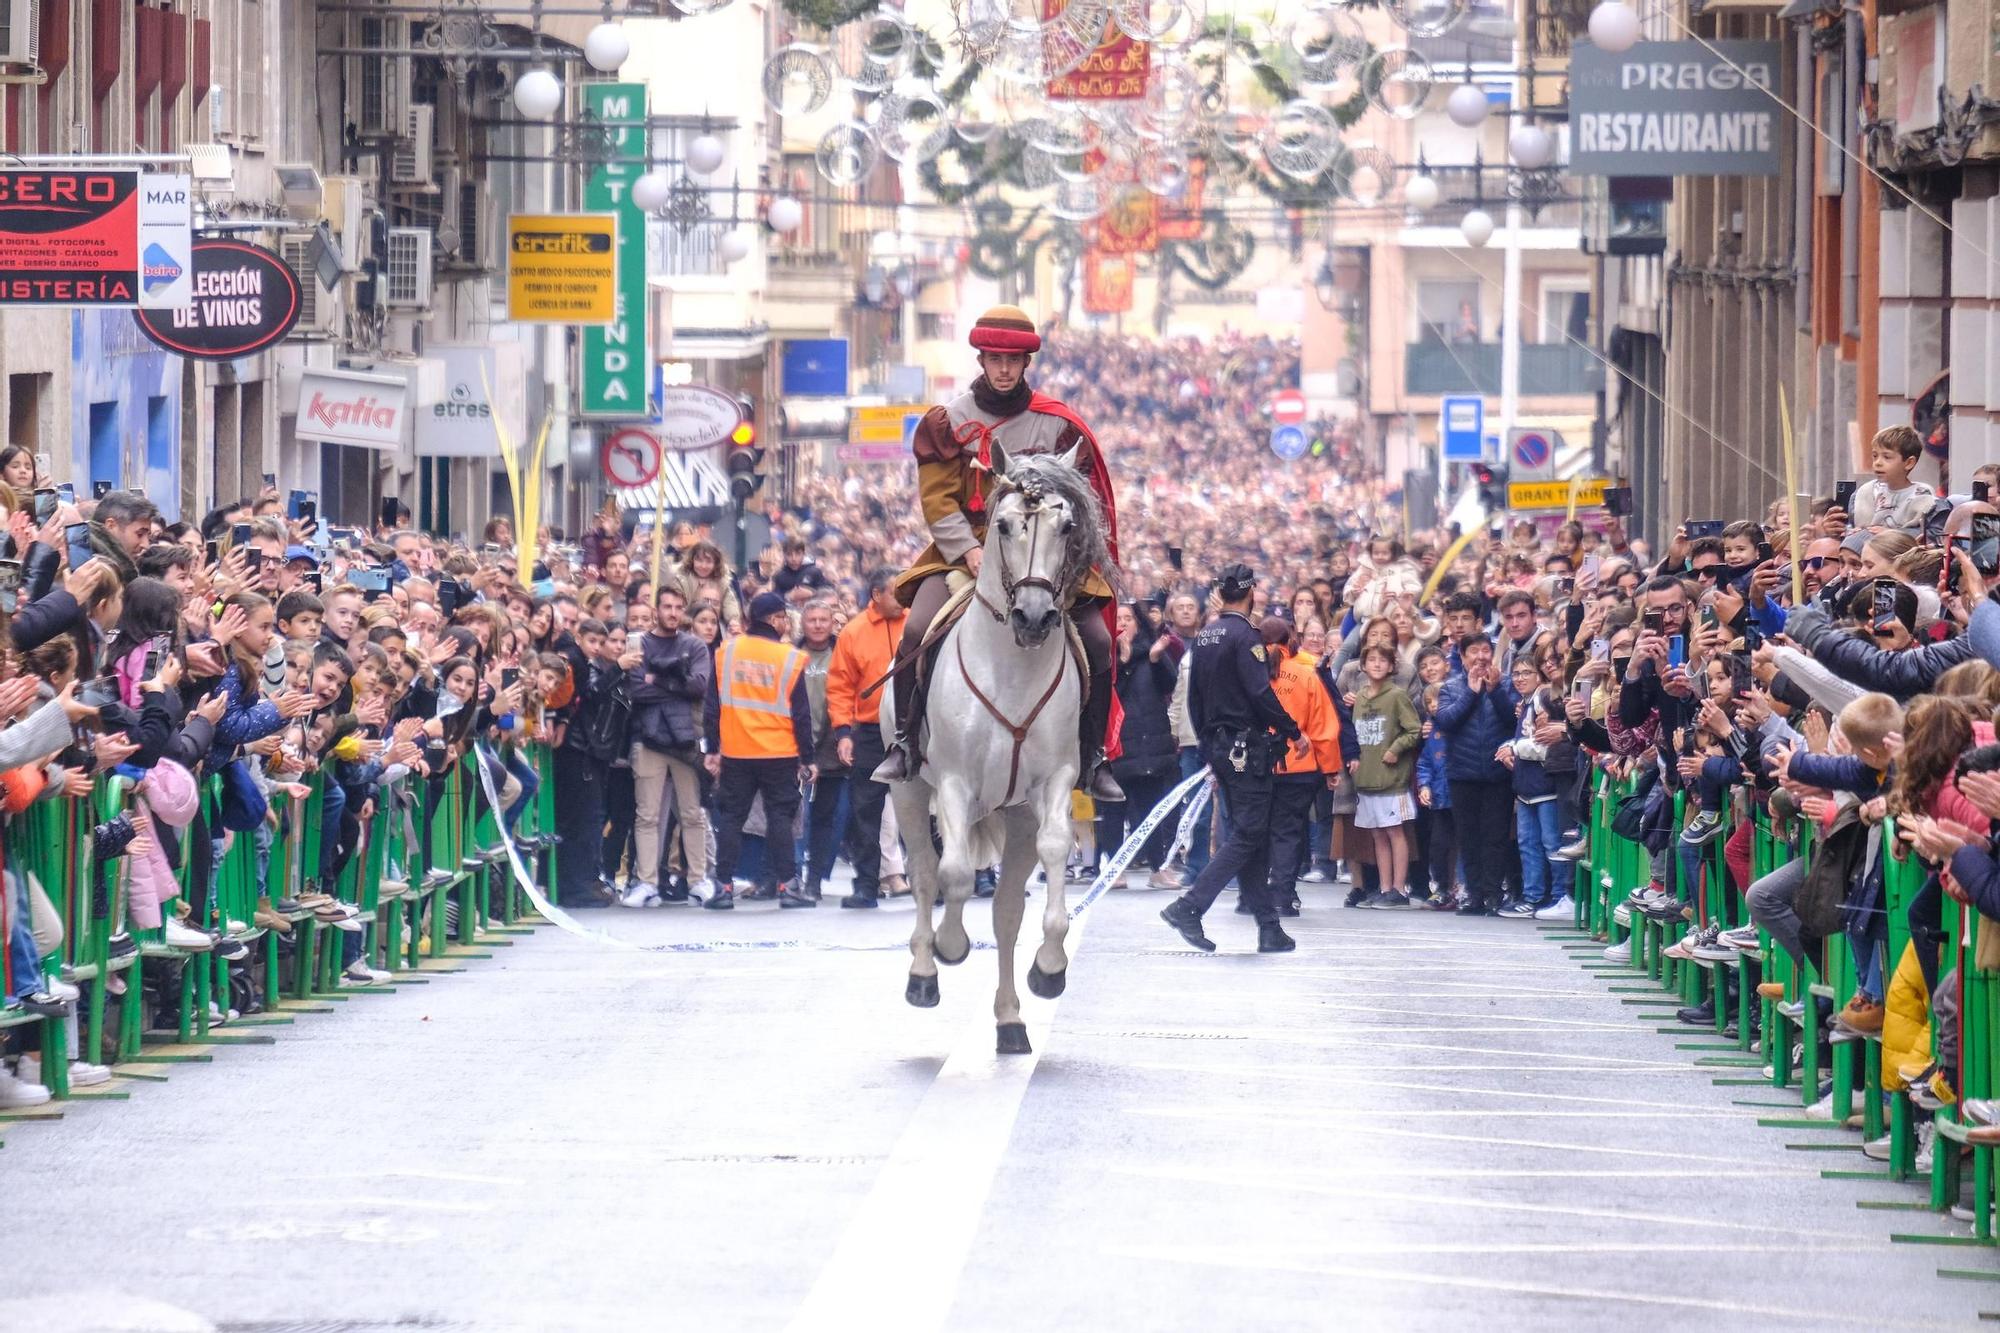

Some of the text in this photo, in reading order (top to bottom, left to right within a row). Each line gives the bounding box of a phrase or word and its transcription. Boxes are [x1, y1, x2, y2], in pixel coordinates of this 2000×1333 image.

[1621, 62, 1770, 90] PRAGA
[1579, 112, 1771, 152] RESTAURANTE
[147, 191, 186, 204] MAR
[515, 233, 592, 254] trafik
[173, 298, 262, 328] DE VINOS
[433, 401, 490, 418] etres
[1514, 489, 1553, 504] GRAN
